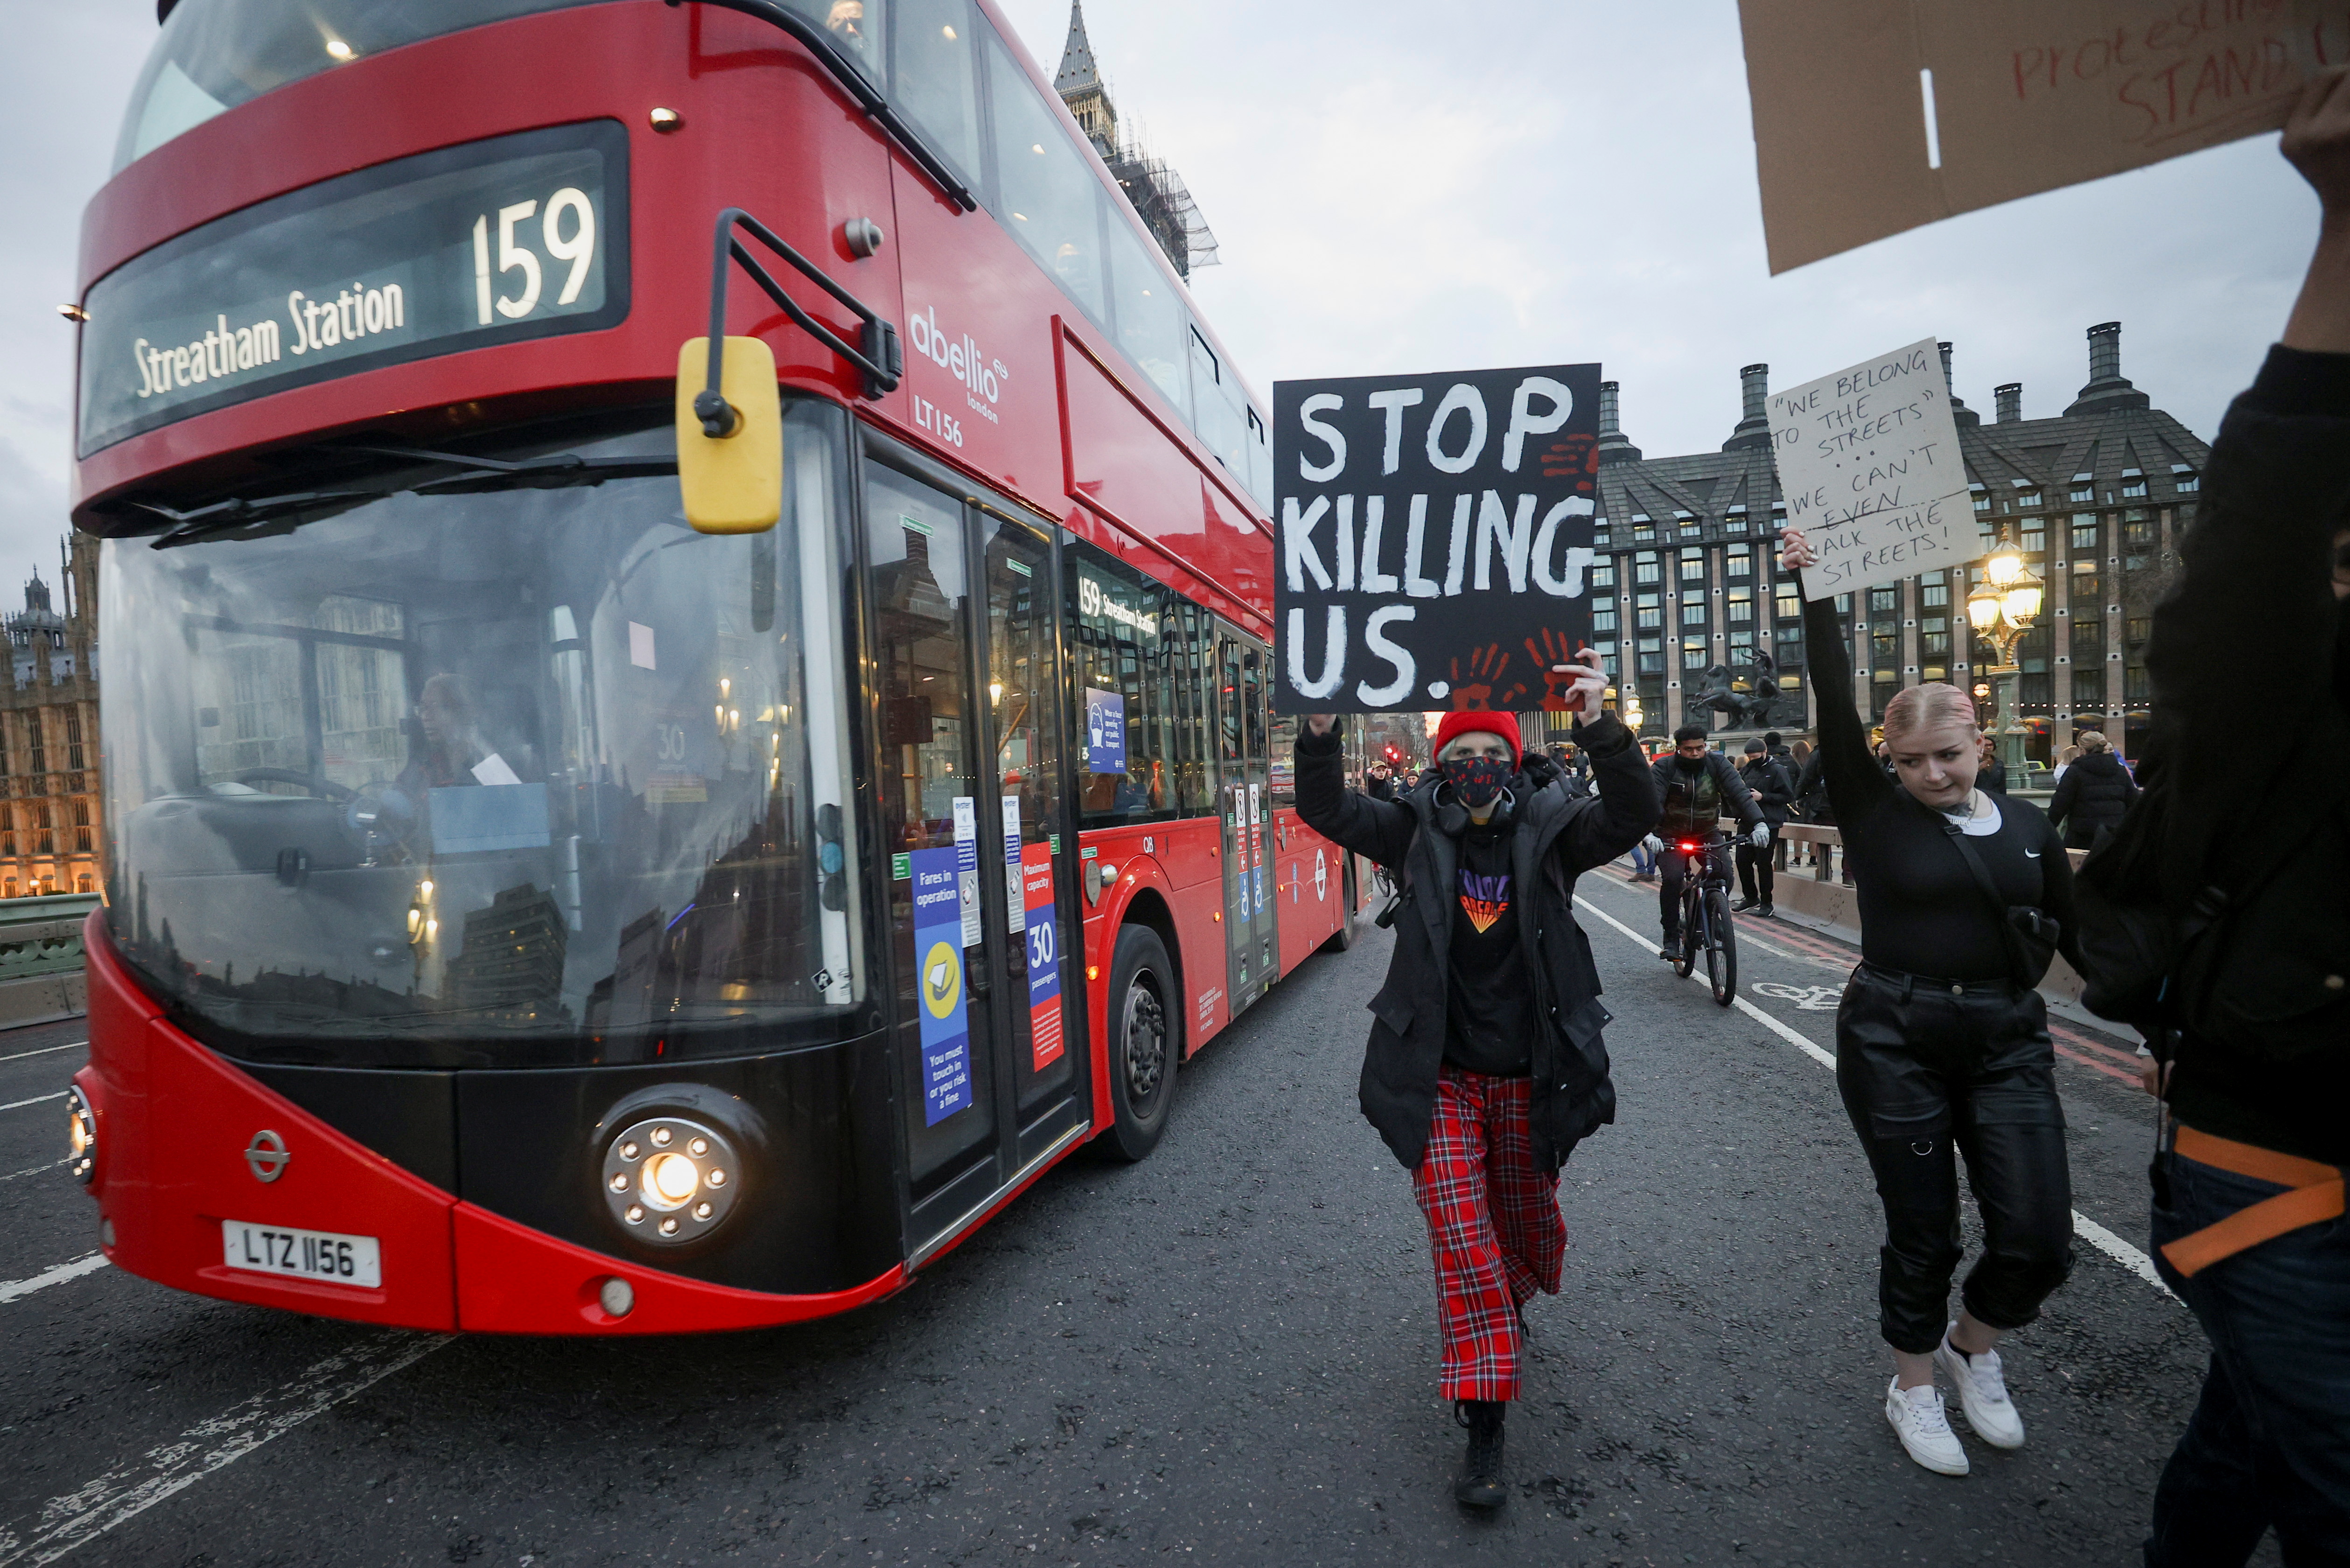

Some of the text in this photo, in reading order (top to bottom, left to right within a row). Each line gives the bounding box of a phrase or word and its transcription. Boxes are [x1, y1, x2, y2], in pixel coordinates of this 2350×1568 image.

[2118, 35, 2289, 125] STAND
[134, 187, 595, 398] Streatham Station 159
[910, 305, 999, 404] abellio
[1837, 350, 1927, 398] BELONG
[967, 391, 999, 425] london
[1300, 376, 1573, 483] STOP
[1773, 394, 1872, 450] TO THE
[1792, 443, 1937, 515] WE CAN'T
[1813, 503, 1942, 556] ALK THE
[1824, 485, 1901, 531] EVEN
[1282, 489, 1595, 598] KILLING
[1823, 526, 1949, 585] STREETS!
[1079, 575, 1156, 635] 159 Streatham Station
[1287, 603, 1450, 707] US.
[1143, 836, 1154, 854] QB
[919, 869, 952, 886] Fares in
[1024, 862, 1050, 876] Maximum
[1027, 877, 1049, 892] capacity
[916, 889, 957, 908] operation
[1029, 921, 1054, 968] 30
[1031, 971, 1056, 992] passengers
[929, 1044, 964, 1067] You must
[932, 1060, 962, 1082] touch in
[929, 1071, 967, 1099] or you risk
[939, 1092, 960, 1109] a fine
[243, 1228, 355, 1277] LTZ 1156
